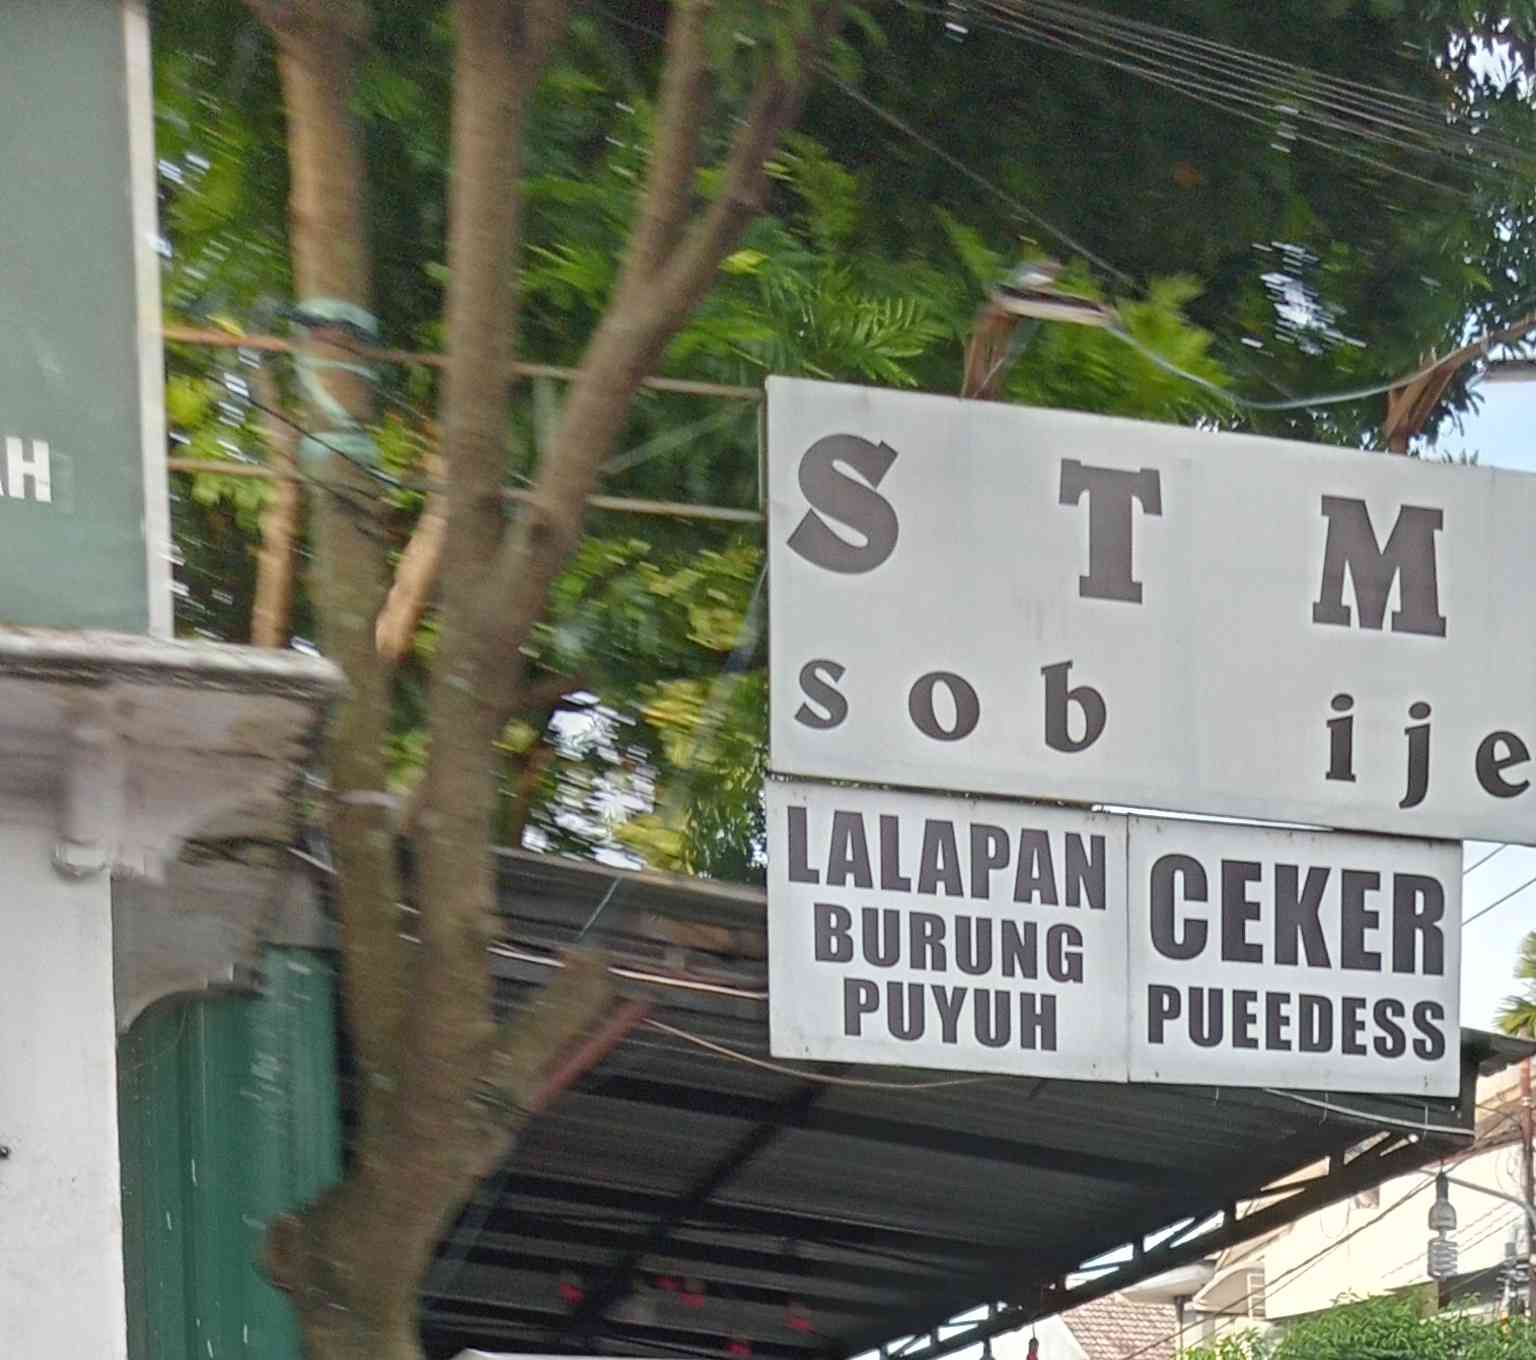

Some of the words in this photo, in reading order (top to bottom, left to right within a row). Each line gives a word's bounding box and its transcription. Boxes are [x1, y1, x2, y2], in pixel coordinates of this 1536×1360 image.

[794, 658, 1108, 753] sob
[785, 805, 1107, 911] LALAPAN
[815, 903, 1084, 984] BURUNG
[1149, 853, 1447, 976] CEKER
[843, 977, 1058, 1052] PUYUH
[1148, 983, 1447, 1062] PUEEDESS
